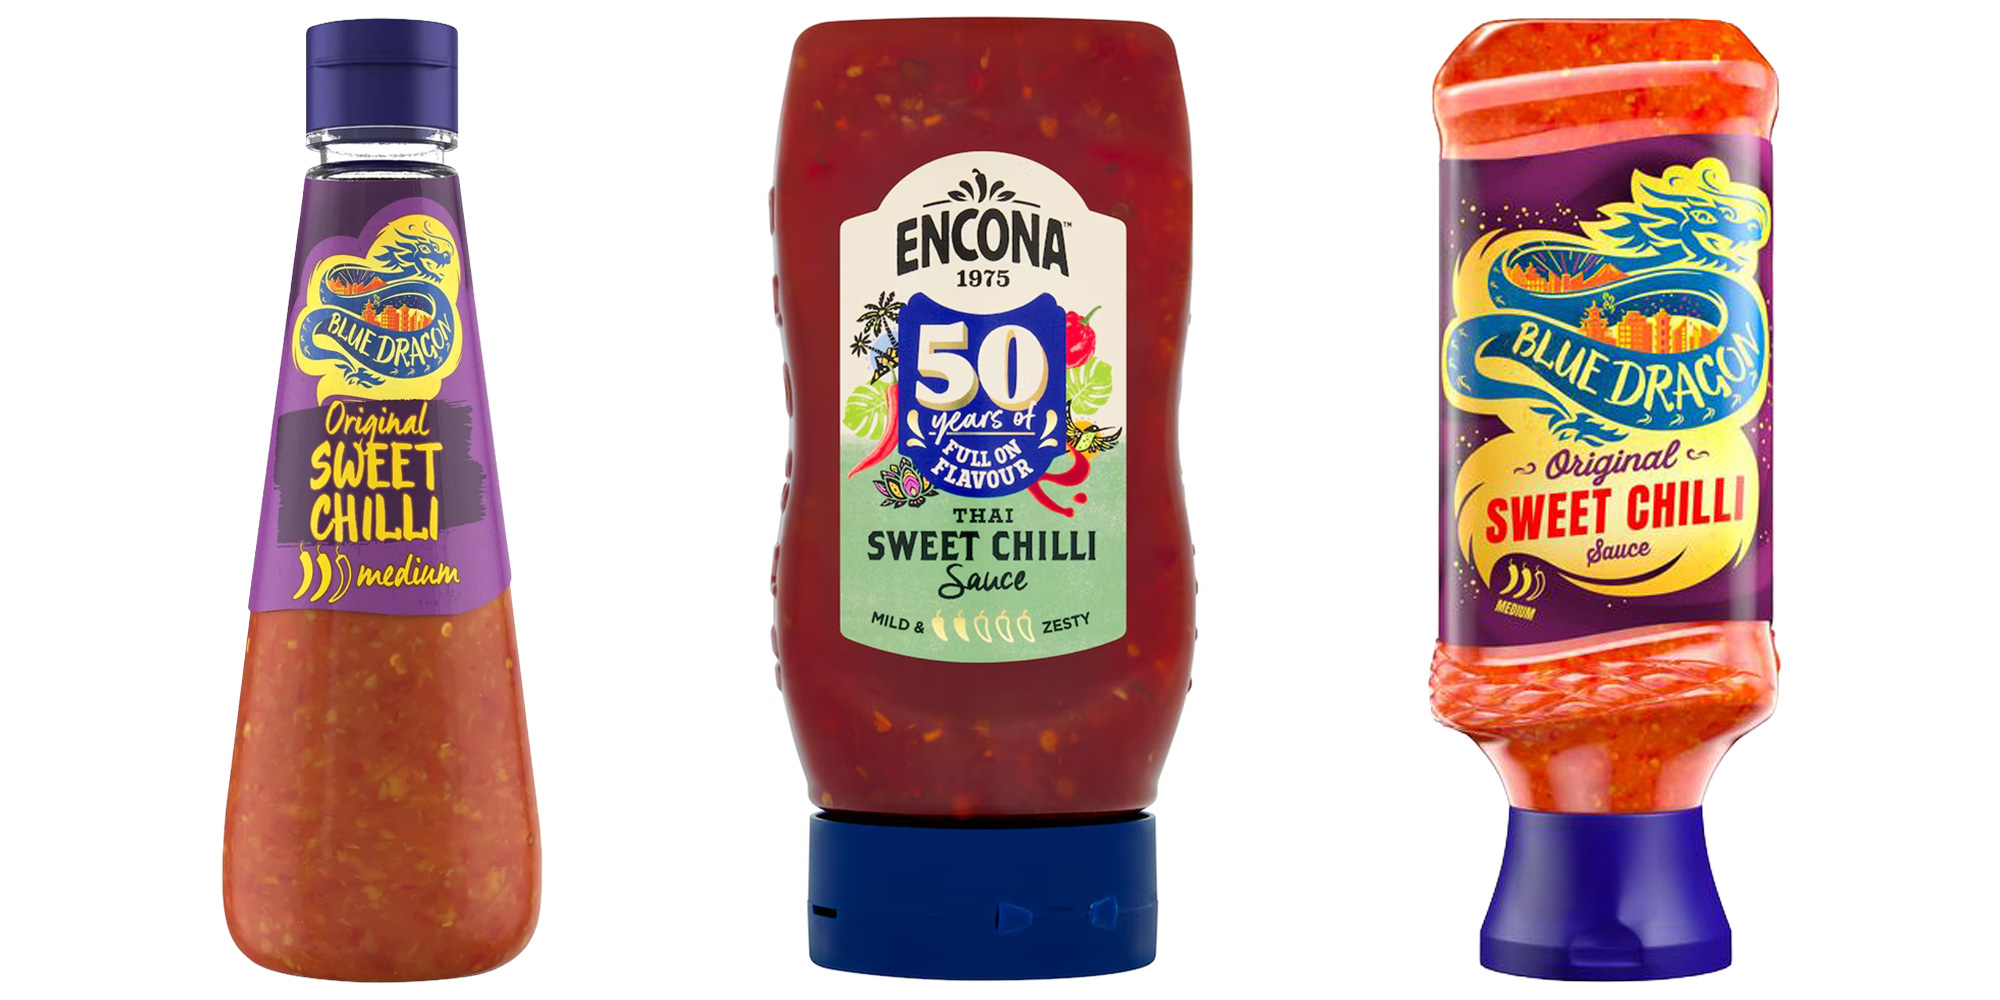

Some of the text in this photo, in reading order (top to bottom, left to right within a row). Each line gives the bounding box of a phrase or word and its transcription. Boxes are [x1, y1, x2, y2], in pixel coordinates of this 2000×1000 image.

[897, 208, 1069, 277] ENCONA
[957, 270, 1010, 287] 1975
[327, 312, 452, 367] BLUE DRAGON
[915, 321, 1049, 411] 50
[1512, 321, 1760, 413] BLUE DRAGON
[325, 400, 430, 443] Original
[931, 400, 1037, 445] years of
[309, 439, 443, 490] SWEET
[942, 438, 1023, 469] FULL ON
[1546, 439, 1681, 486] Original
[930, 458, 1034, 490] FLAVOUR
[309, 492, 439, 543] CHILLI
[953, 508, 1014, 523] THAI
[1486, 475, 1744, 544] SWEET CHILLI
[867, 531, 1096, 561] SWEET CHILLI
[1587, 539, 1651, 567] Sauce
[356, 553, 461, 587] medium
[938, 563, 1028, 600] Sauce
[871, 611, 1091, 634] MILD & ZESTY
[1494, 599, 1537, 621] MEDIUM
